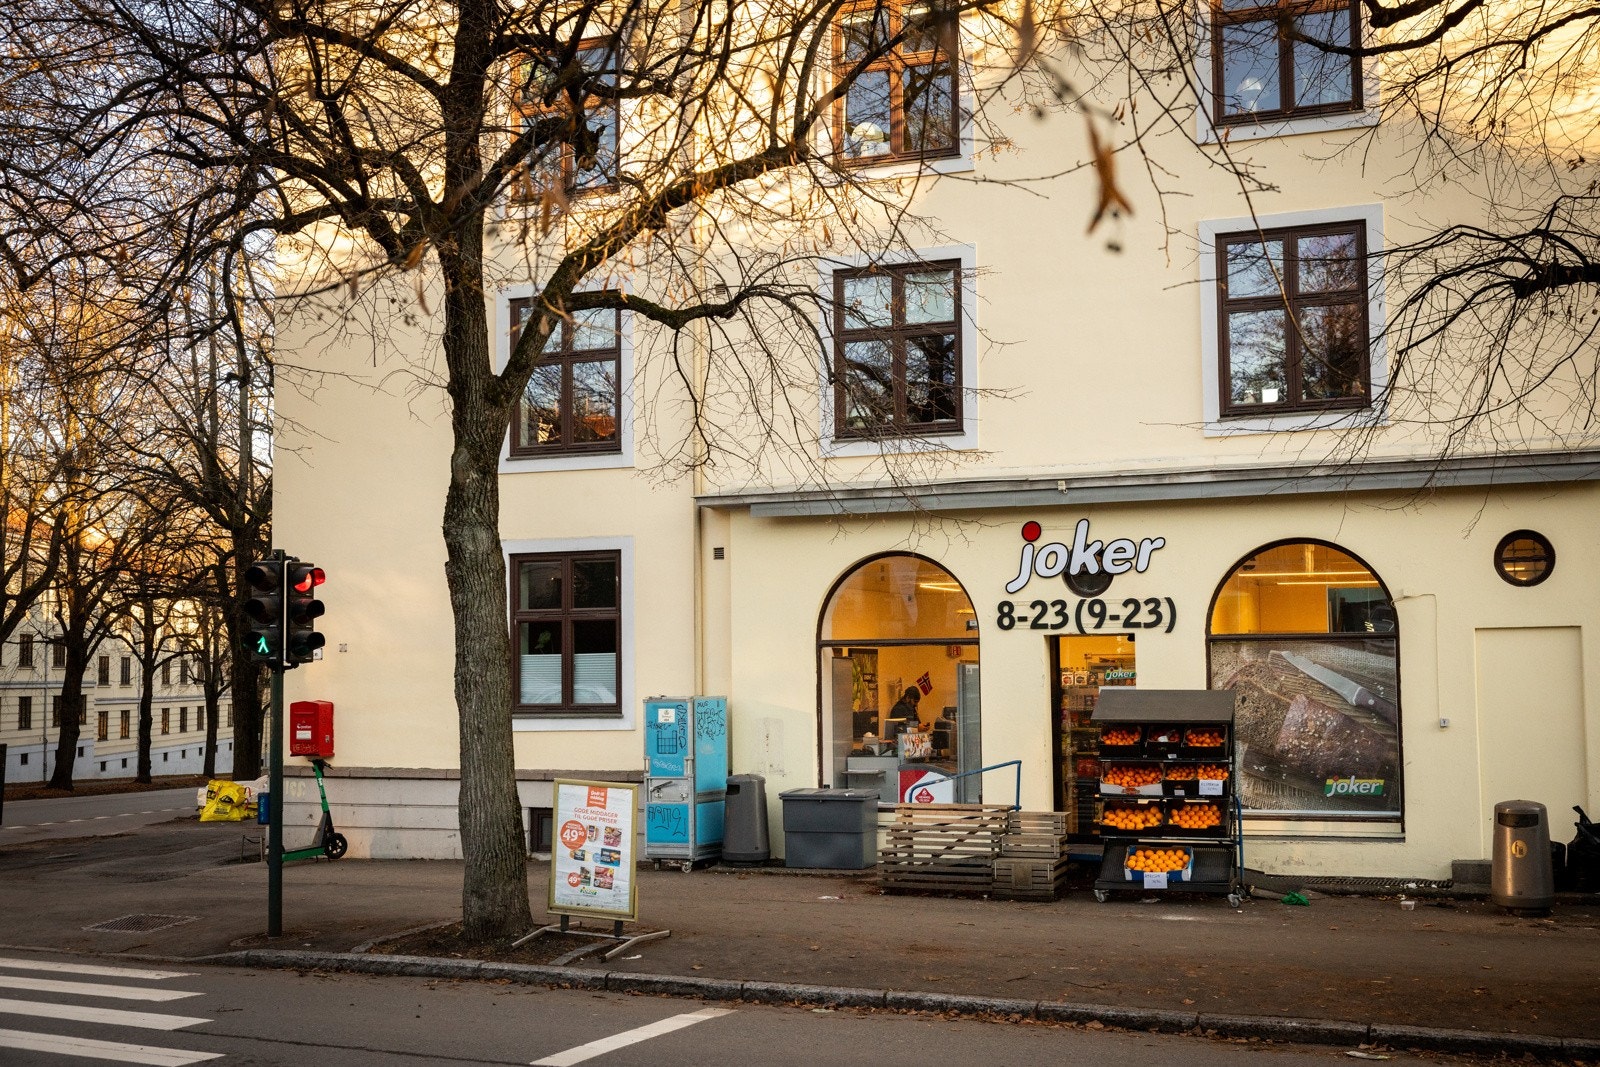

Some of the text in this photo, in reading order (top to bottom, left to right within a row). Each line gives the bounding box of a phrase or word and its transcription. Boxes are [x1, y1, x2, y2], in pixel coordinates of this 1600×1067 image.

[1005, 518, 1166, 594] joker
[1105, 667, 1135, 681] joker
[1326, 775, 1380, 797] joker
